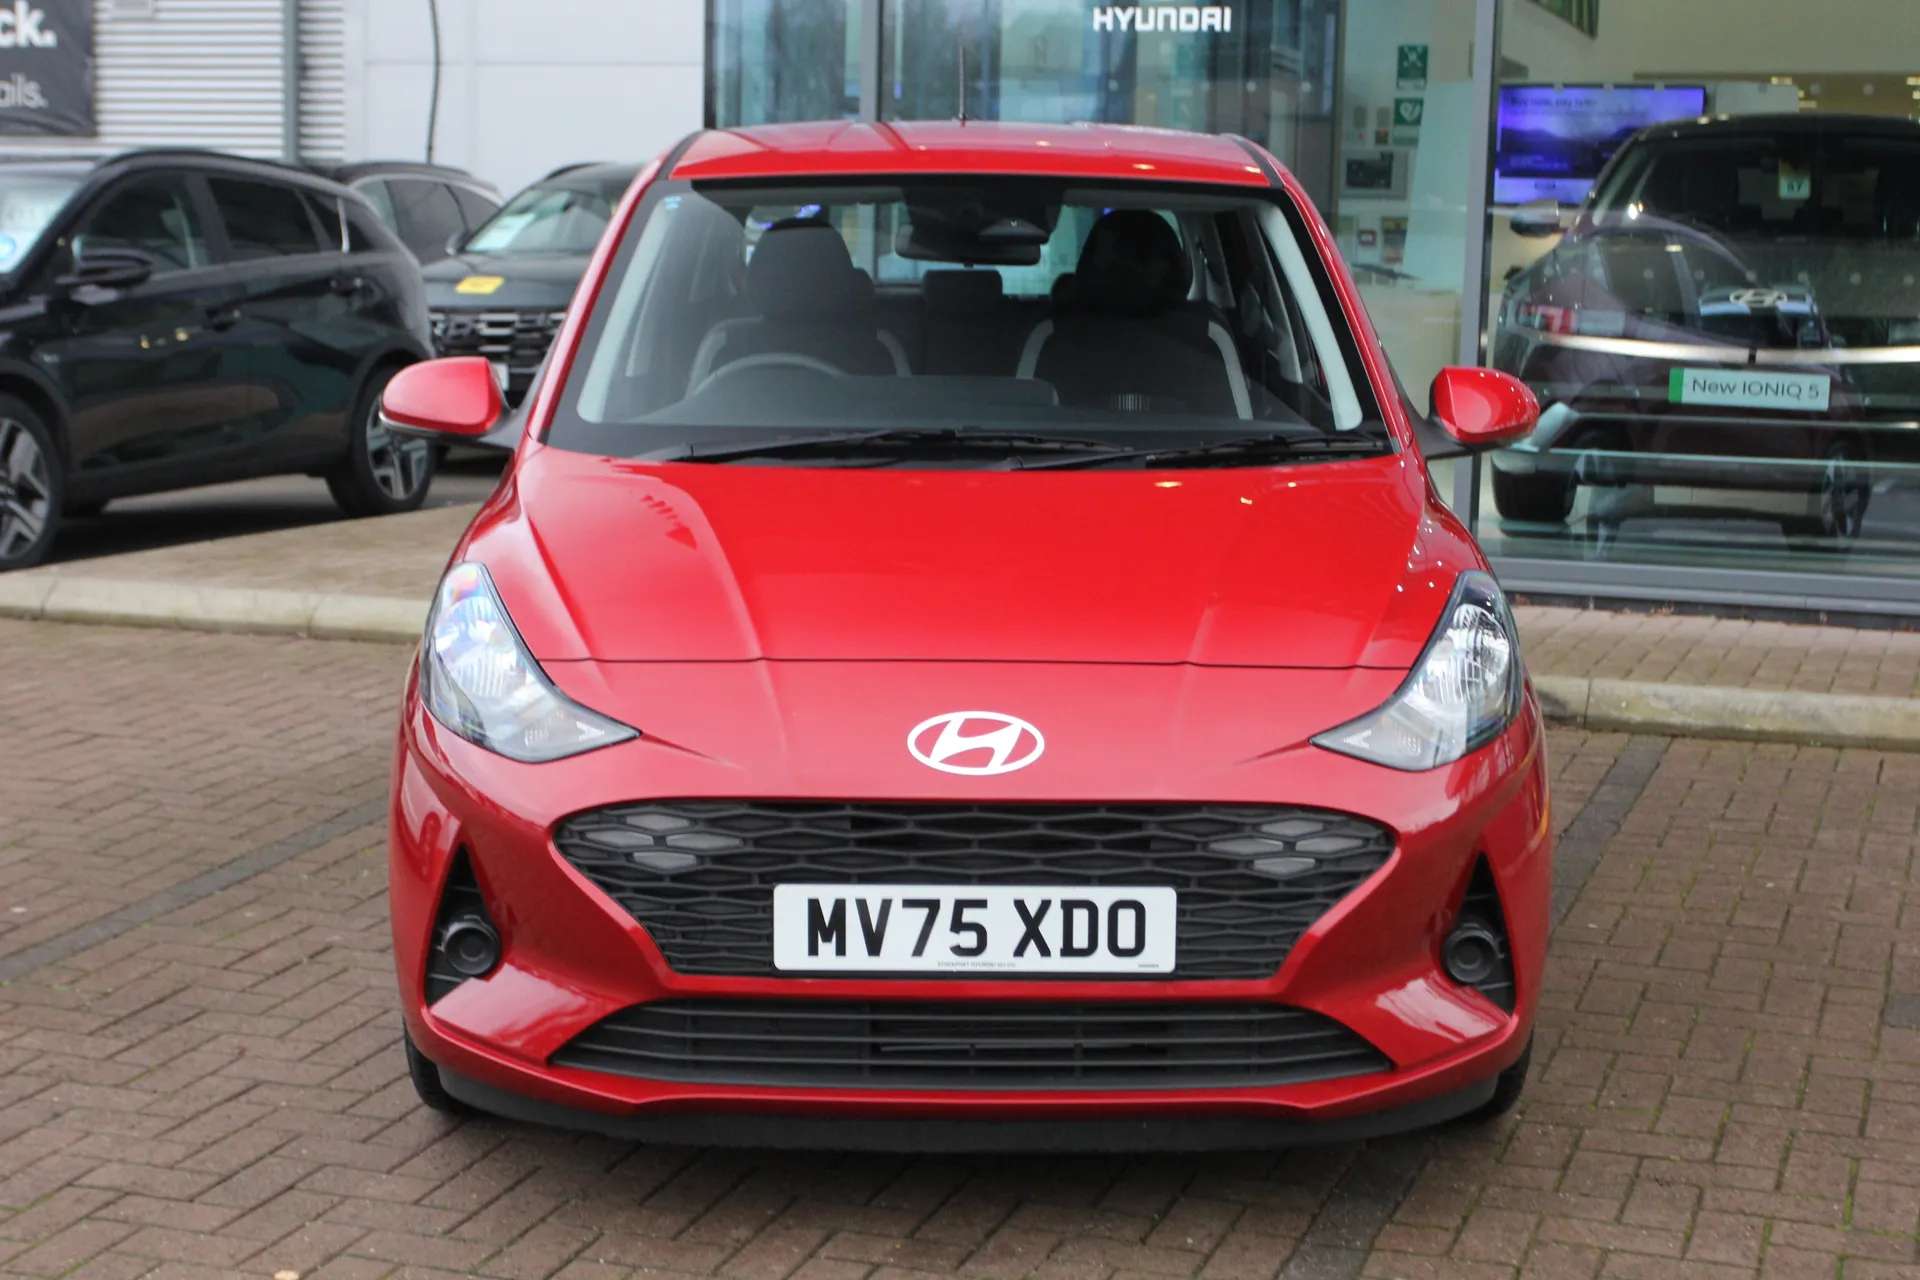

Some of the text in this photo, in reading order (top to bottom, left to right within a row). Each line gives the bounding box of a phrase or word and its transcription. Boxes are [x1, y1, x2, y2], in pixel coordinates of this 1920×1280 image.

[1093, 6, 1232, 32] HYUNDAI
[1692, 378, 1820, 400] New IONIQ 5
[807, 898, 1146, 958] MV75 XDO
